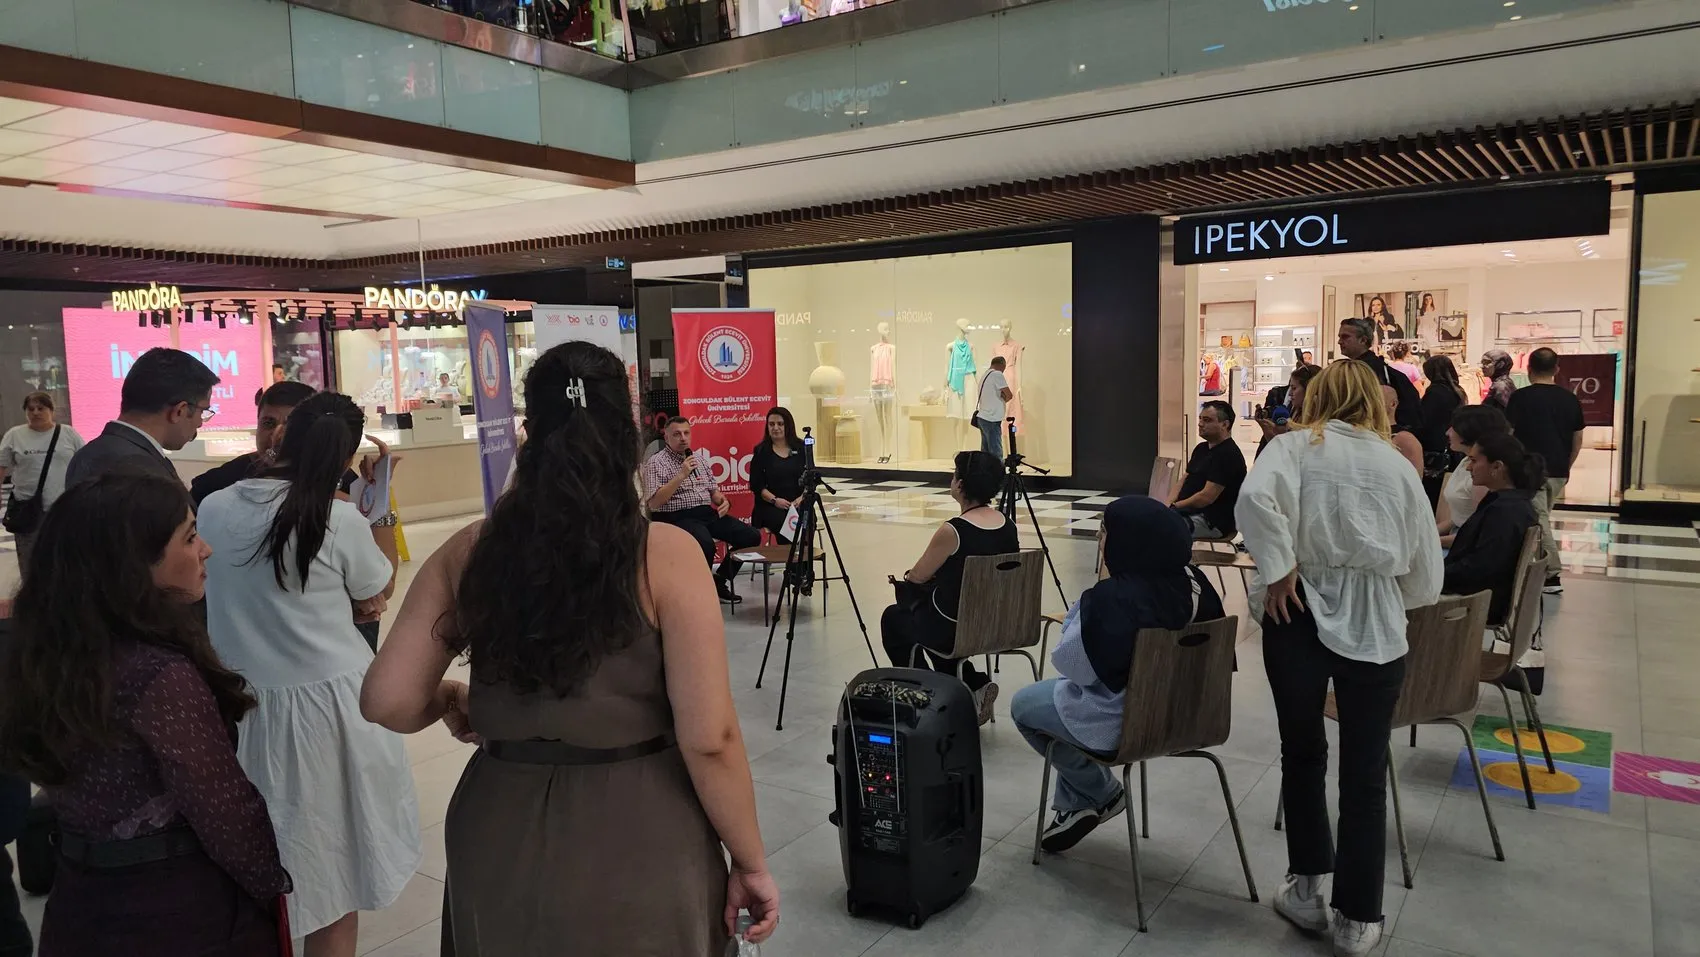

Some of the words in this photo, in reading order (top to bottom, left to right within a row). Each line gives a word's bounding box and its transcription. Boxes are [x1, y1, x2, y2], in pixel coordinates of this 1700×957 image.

[1195, 213, 1349, 256] IPEKYOL
[111, 284, 182, 312] PANDORA
[1569, 377, 1600, 396] 70
[683, 397, 723, 405] ZONGULDAK
[724, 395, 749, 403] BÜLENT
[750, 394, 771, 402] ECEVİT
[708, 403, 751, 412] ÜNİVERSİTESİ
